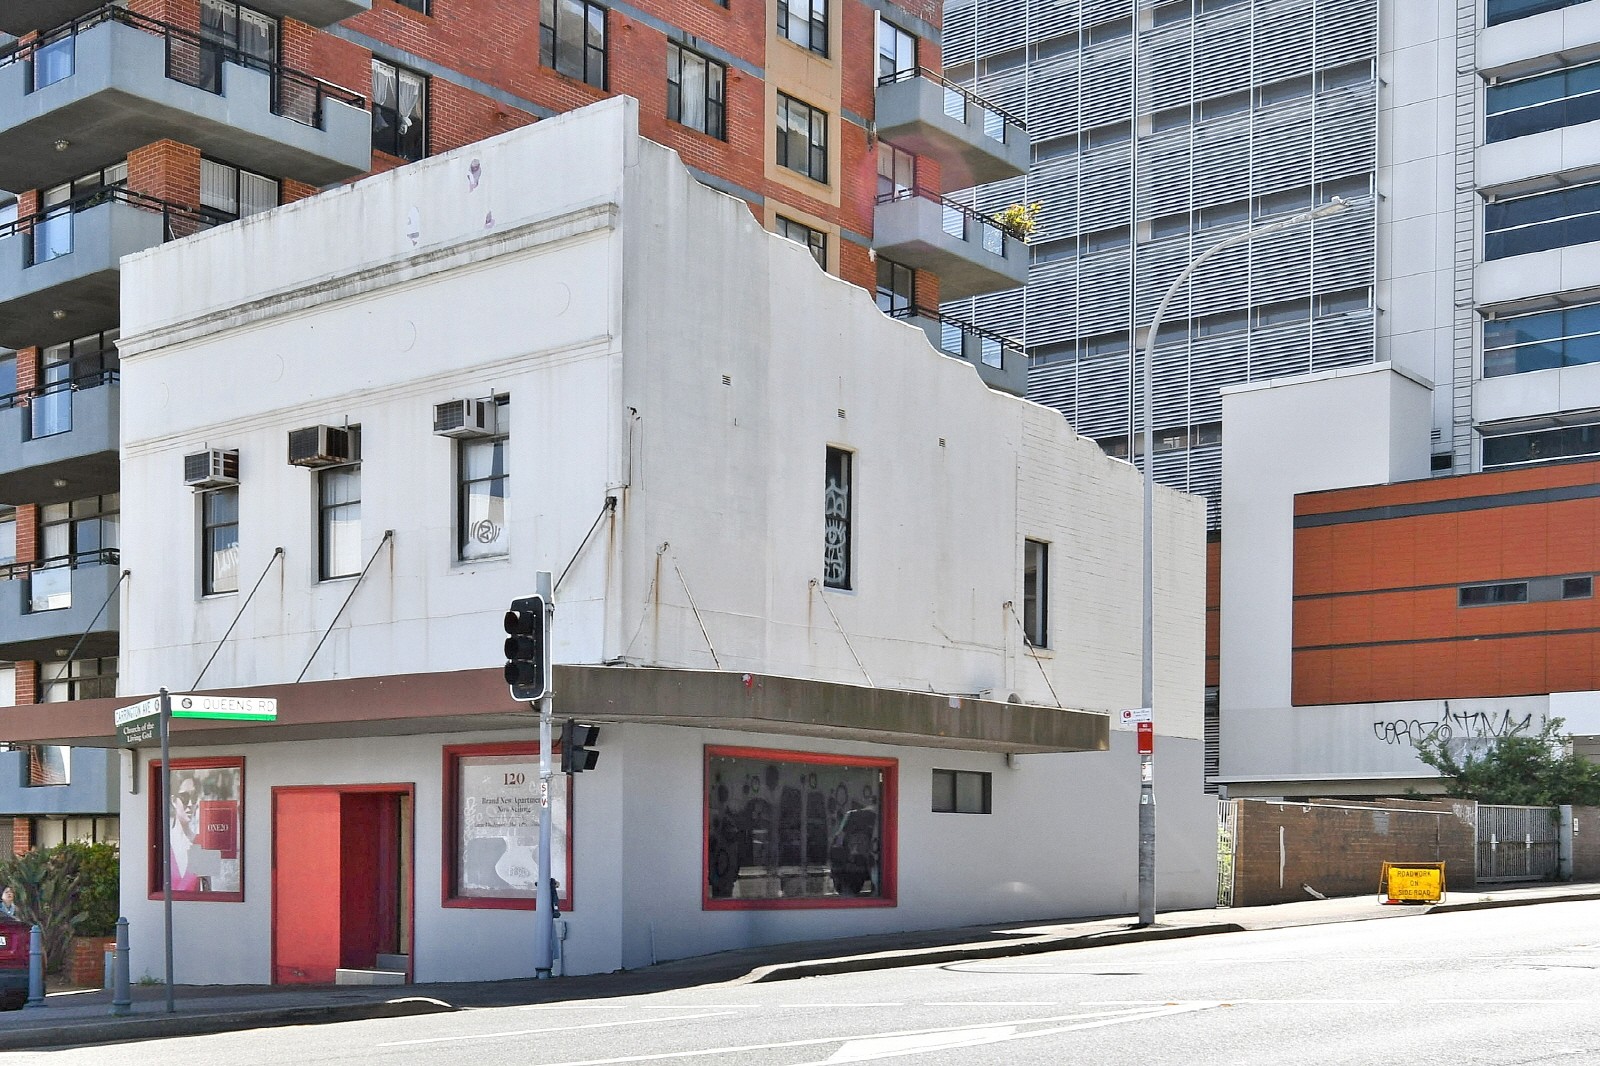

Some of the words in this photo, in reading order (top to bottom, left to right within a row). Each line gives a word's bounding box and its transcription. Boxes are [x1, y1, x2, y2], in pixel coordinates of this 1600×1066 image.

[203, 698, 253, 712] QUEENS
[258, 700, 275, 713] RD
[123, 724, 141, 735] Church
[141, 722, 147, 731] of
[147, 721, 155, 730] the
[127, 734, 142, 743] Living
[142, 730, 153, 740] God
[504, 772, 525, 785] 120
